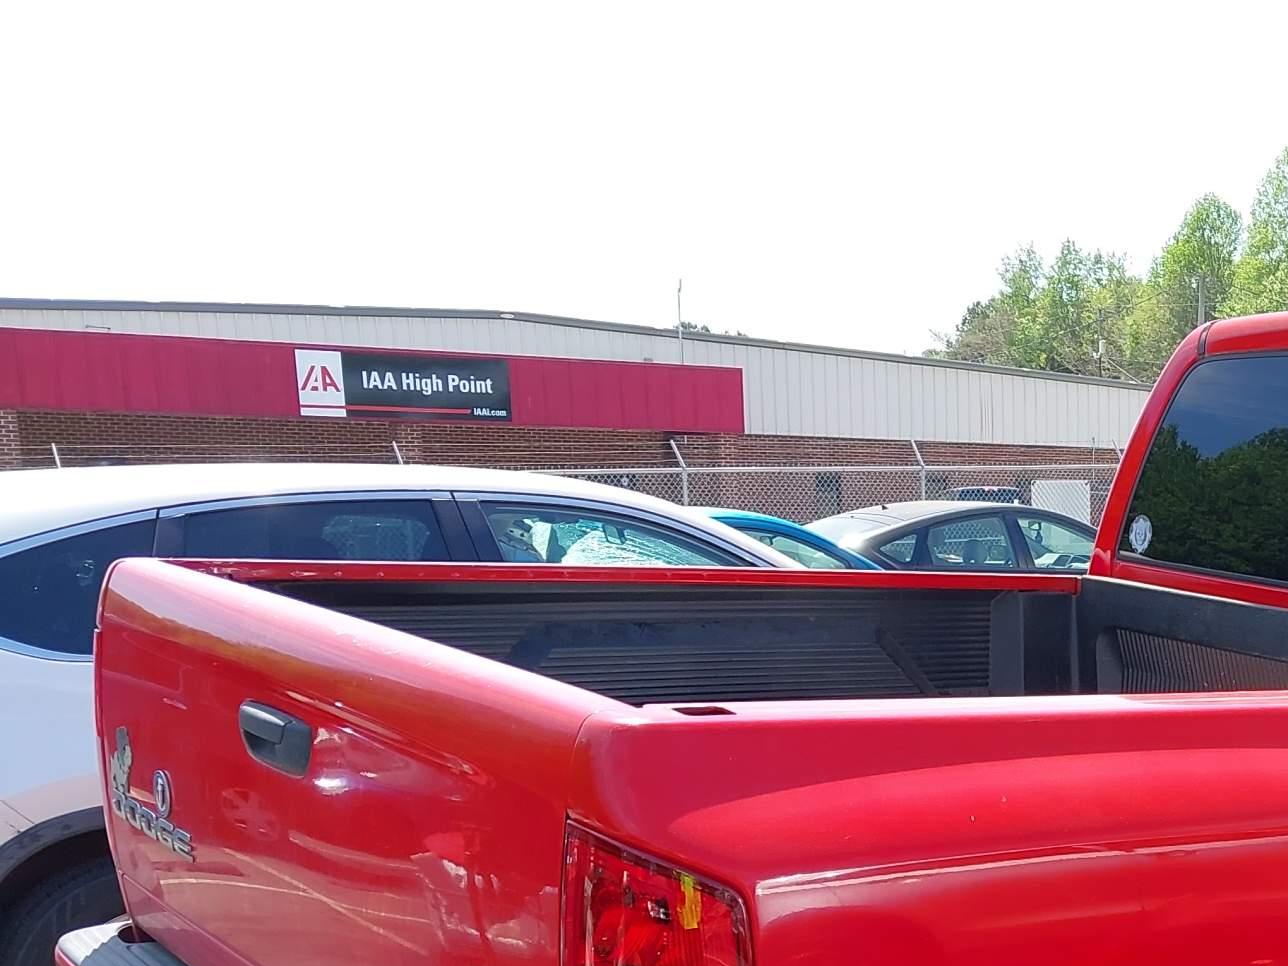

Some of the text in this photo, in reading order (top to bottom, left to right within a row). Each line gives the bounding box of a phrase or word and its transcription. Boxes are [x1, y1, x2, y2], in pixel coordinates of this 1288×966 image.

[361, 370, 493, 395] IAA High Point
